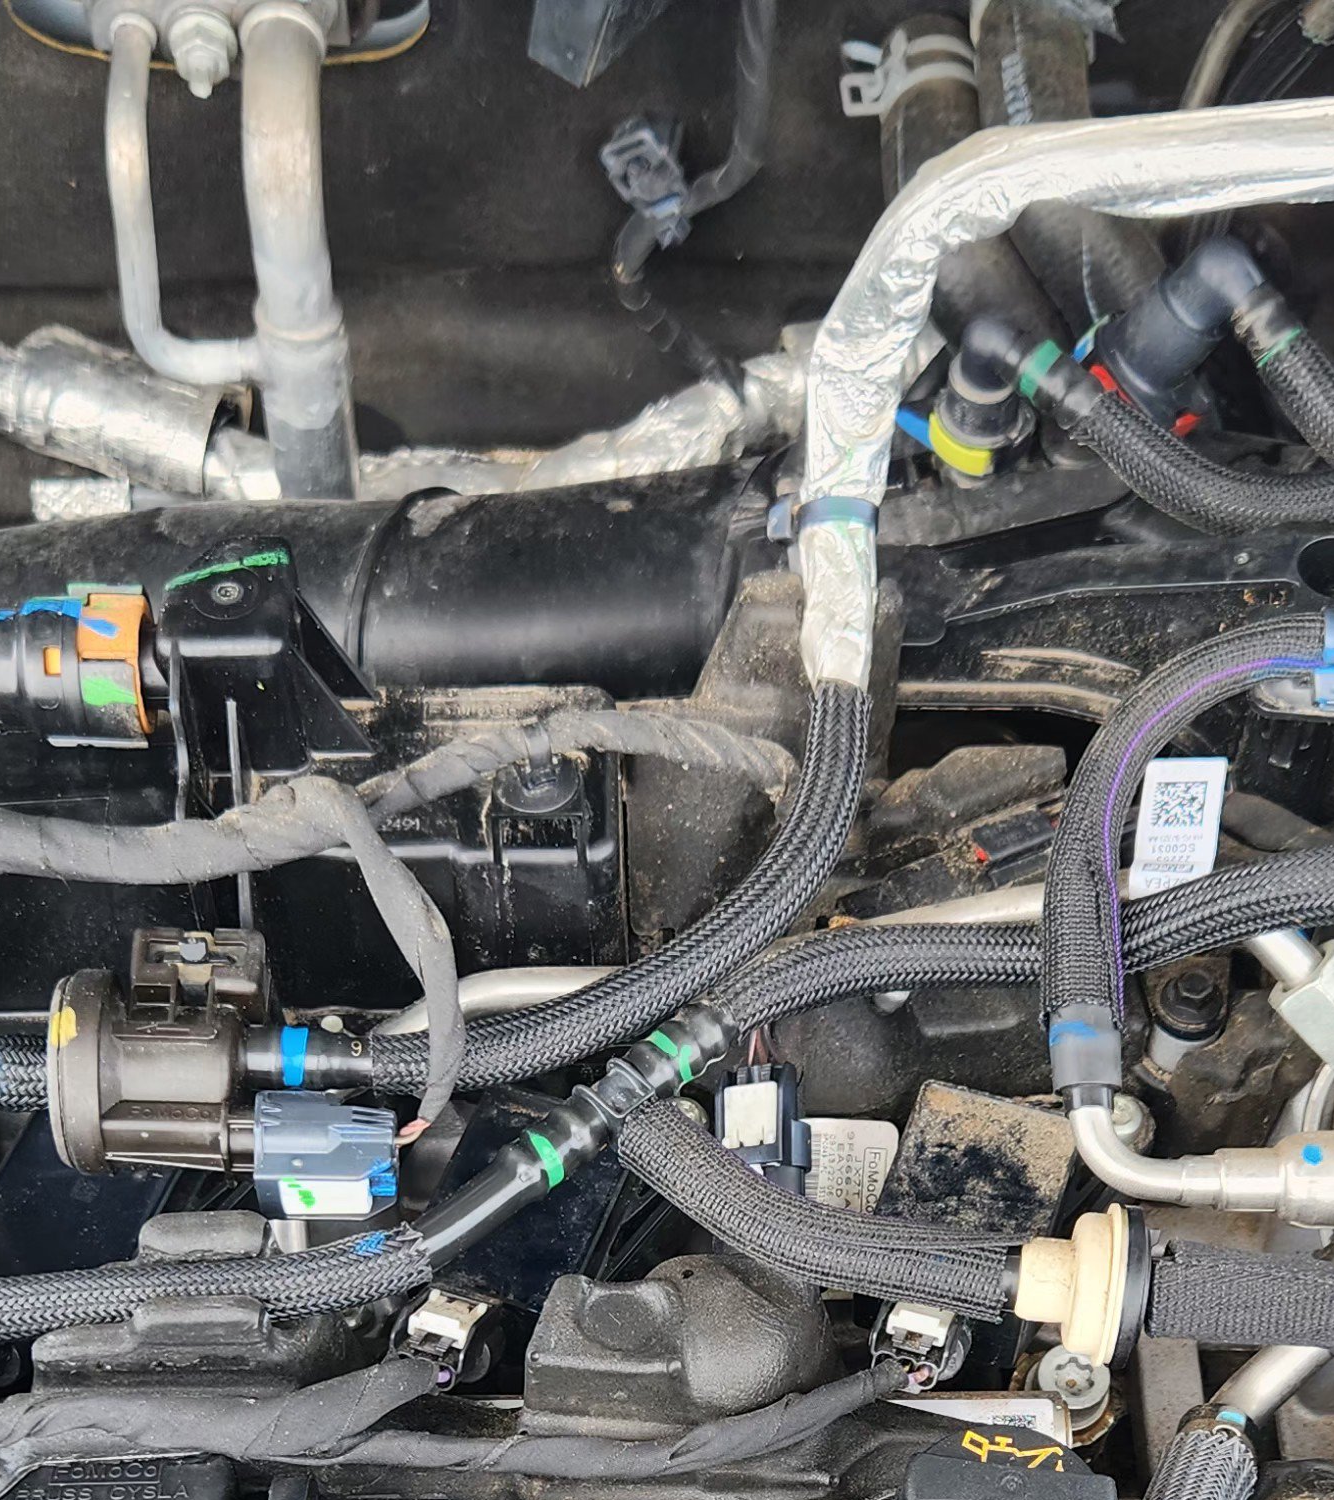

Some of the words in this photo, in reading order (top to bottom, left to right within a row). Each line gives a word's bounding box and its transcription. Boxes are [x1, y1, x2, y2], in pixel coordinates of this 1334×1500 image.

[350, 1040, 363, 1057] 9
[864, 1150, 881, 1214] FoMoCo
[54, 1462, 158, 1480] FoMoCo
